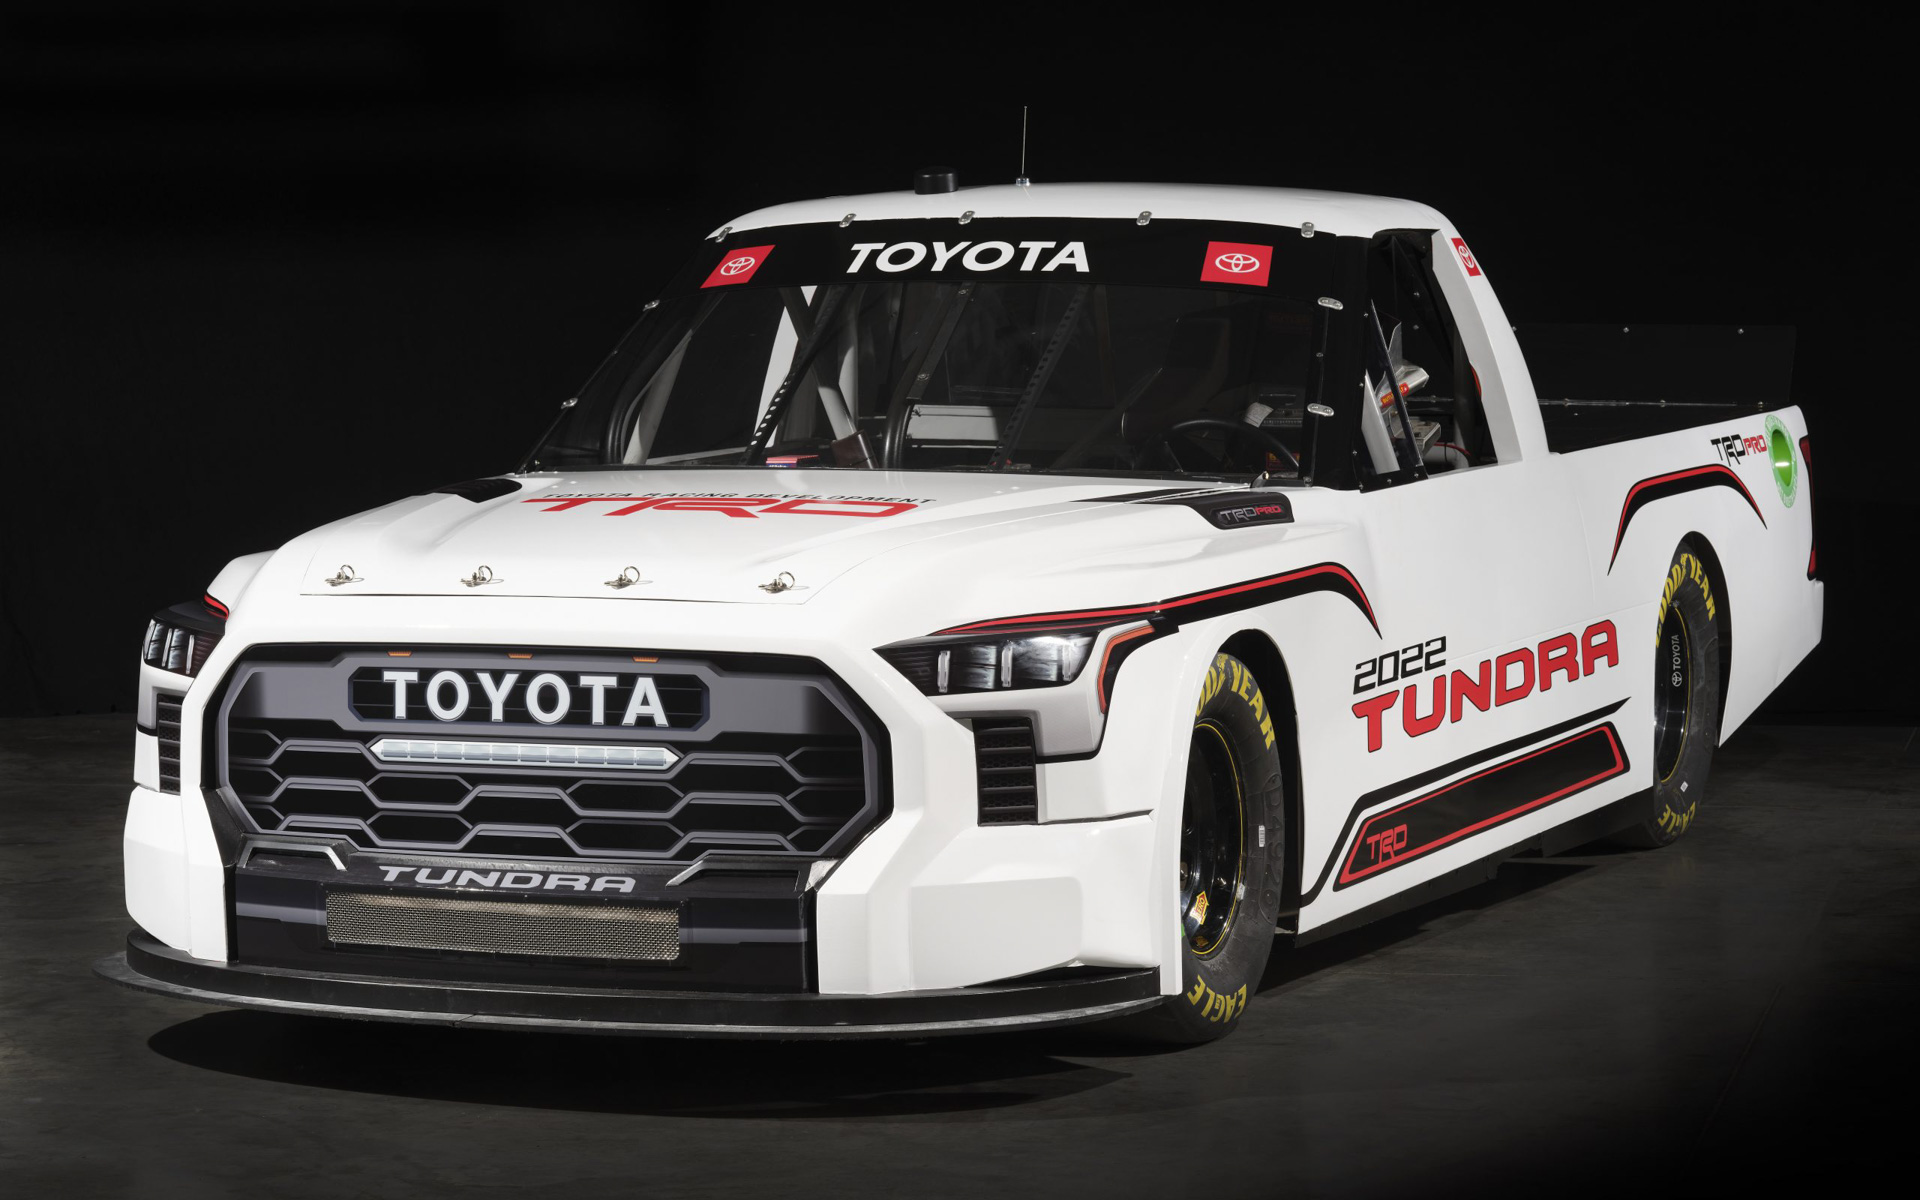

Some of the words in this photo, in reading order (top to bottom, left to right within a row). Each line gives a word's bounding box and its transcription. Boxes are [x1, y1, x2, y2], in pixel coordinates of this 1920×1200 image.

[846, 240, 1090, 274] TOYOTA
[520, 496, 919, 519] TRD
[745, 493, 937, 504] DEVELOPMENT
[1353, 635, 1447, 695] 2022
[1671, 634, 1682, 671] TOYOTA
[382, 670, 670, 728] TOYOTA
[1351, 618, 1620, 753] TUNDRA
[1366, 823, 1408, 865] TRD
[378, 865, 637, 893] TUNDRA
[1187, 974, 1247, 1024] EAGLE
